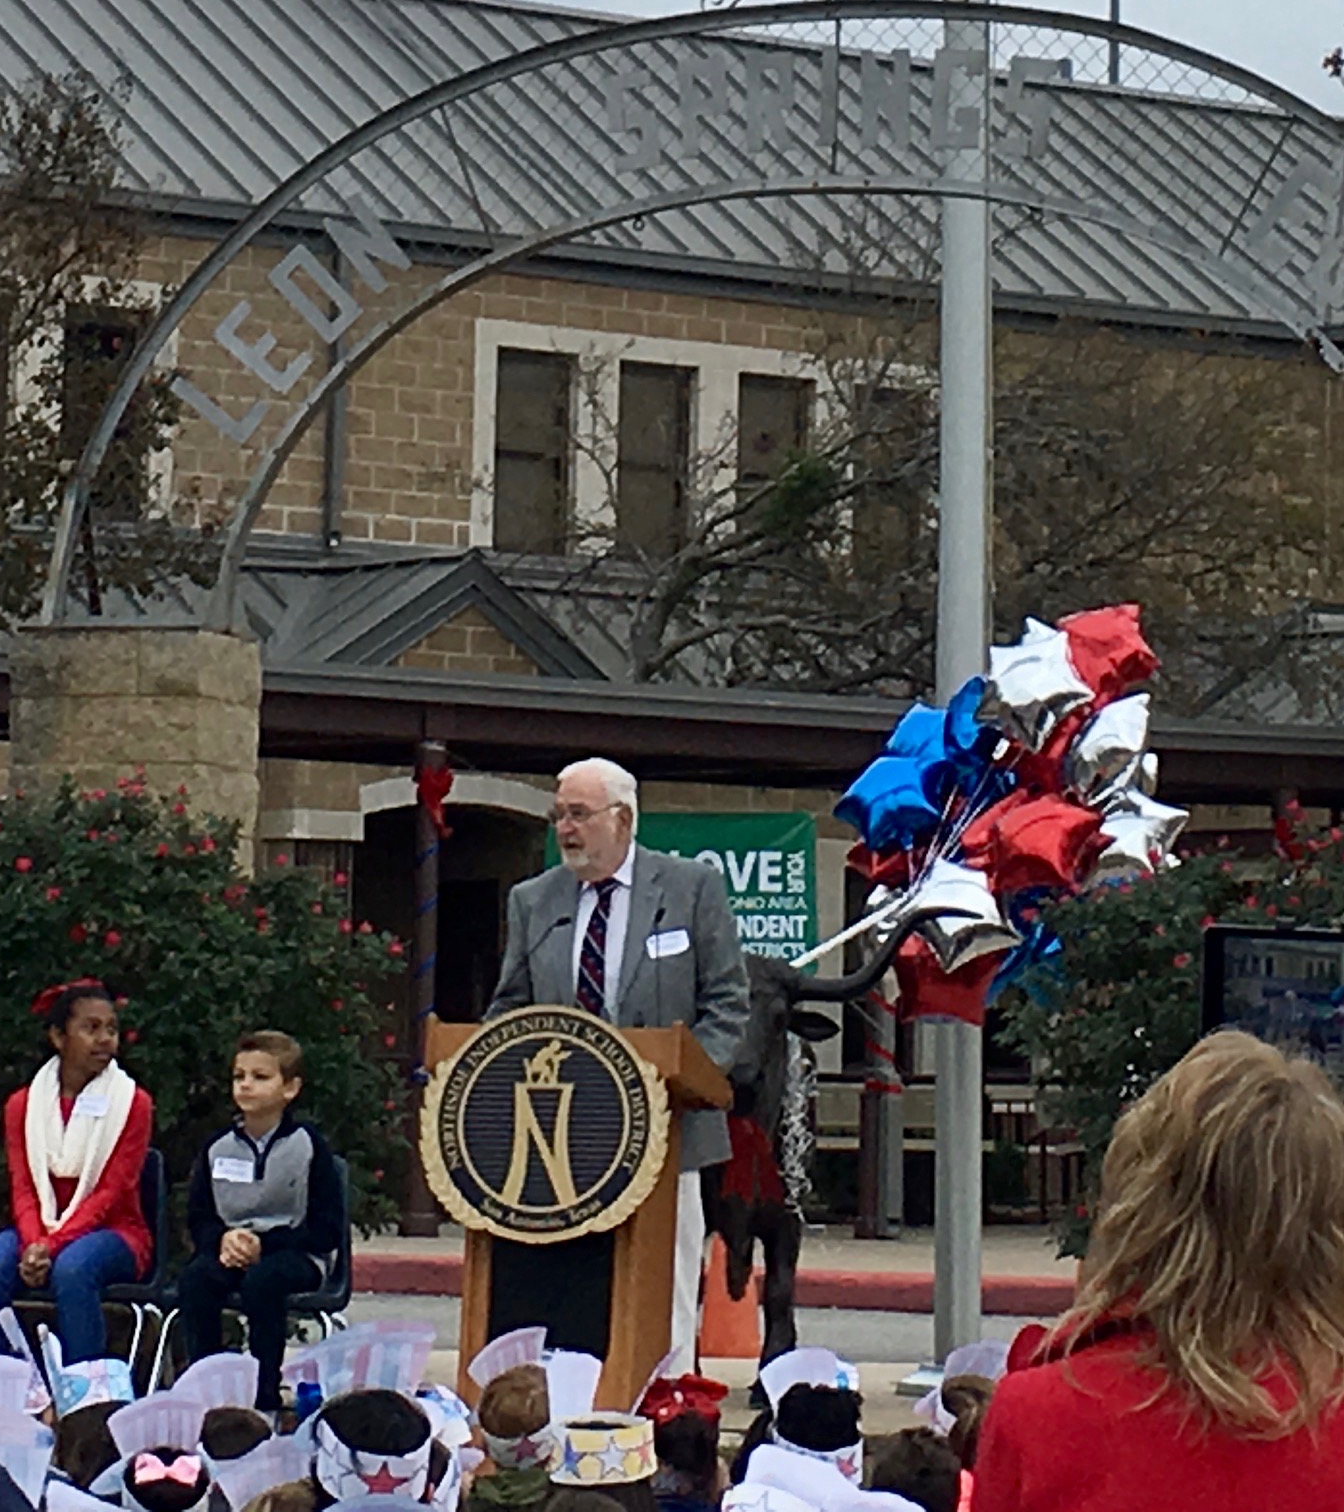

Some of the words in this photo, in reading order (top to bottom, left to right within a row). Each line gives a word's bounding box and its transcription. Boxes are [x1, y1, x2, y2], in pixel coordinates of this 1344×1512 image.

[170, 193, 413, 444] LEON
[602, 48, 1072, 172] SPRINGS
[767, 896, 807, 910] AREA
[786, 850, 806, 893] YOUR
[464, 1015, 582, 1067] INDEPENDENT
[584, 1026, 637, 1084] SCHOOL
[623, 1086, 646, 1174] DISTRICT
